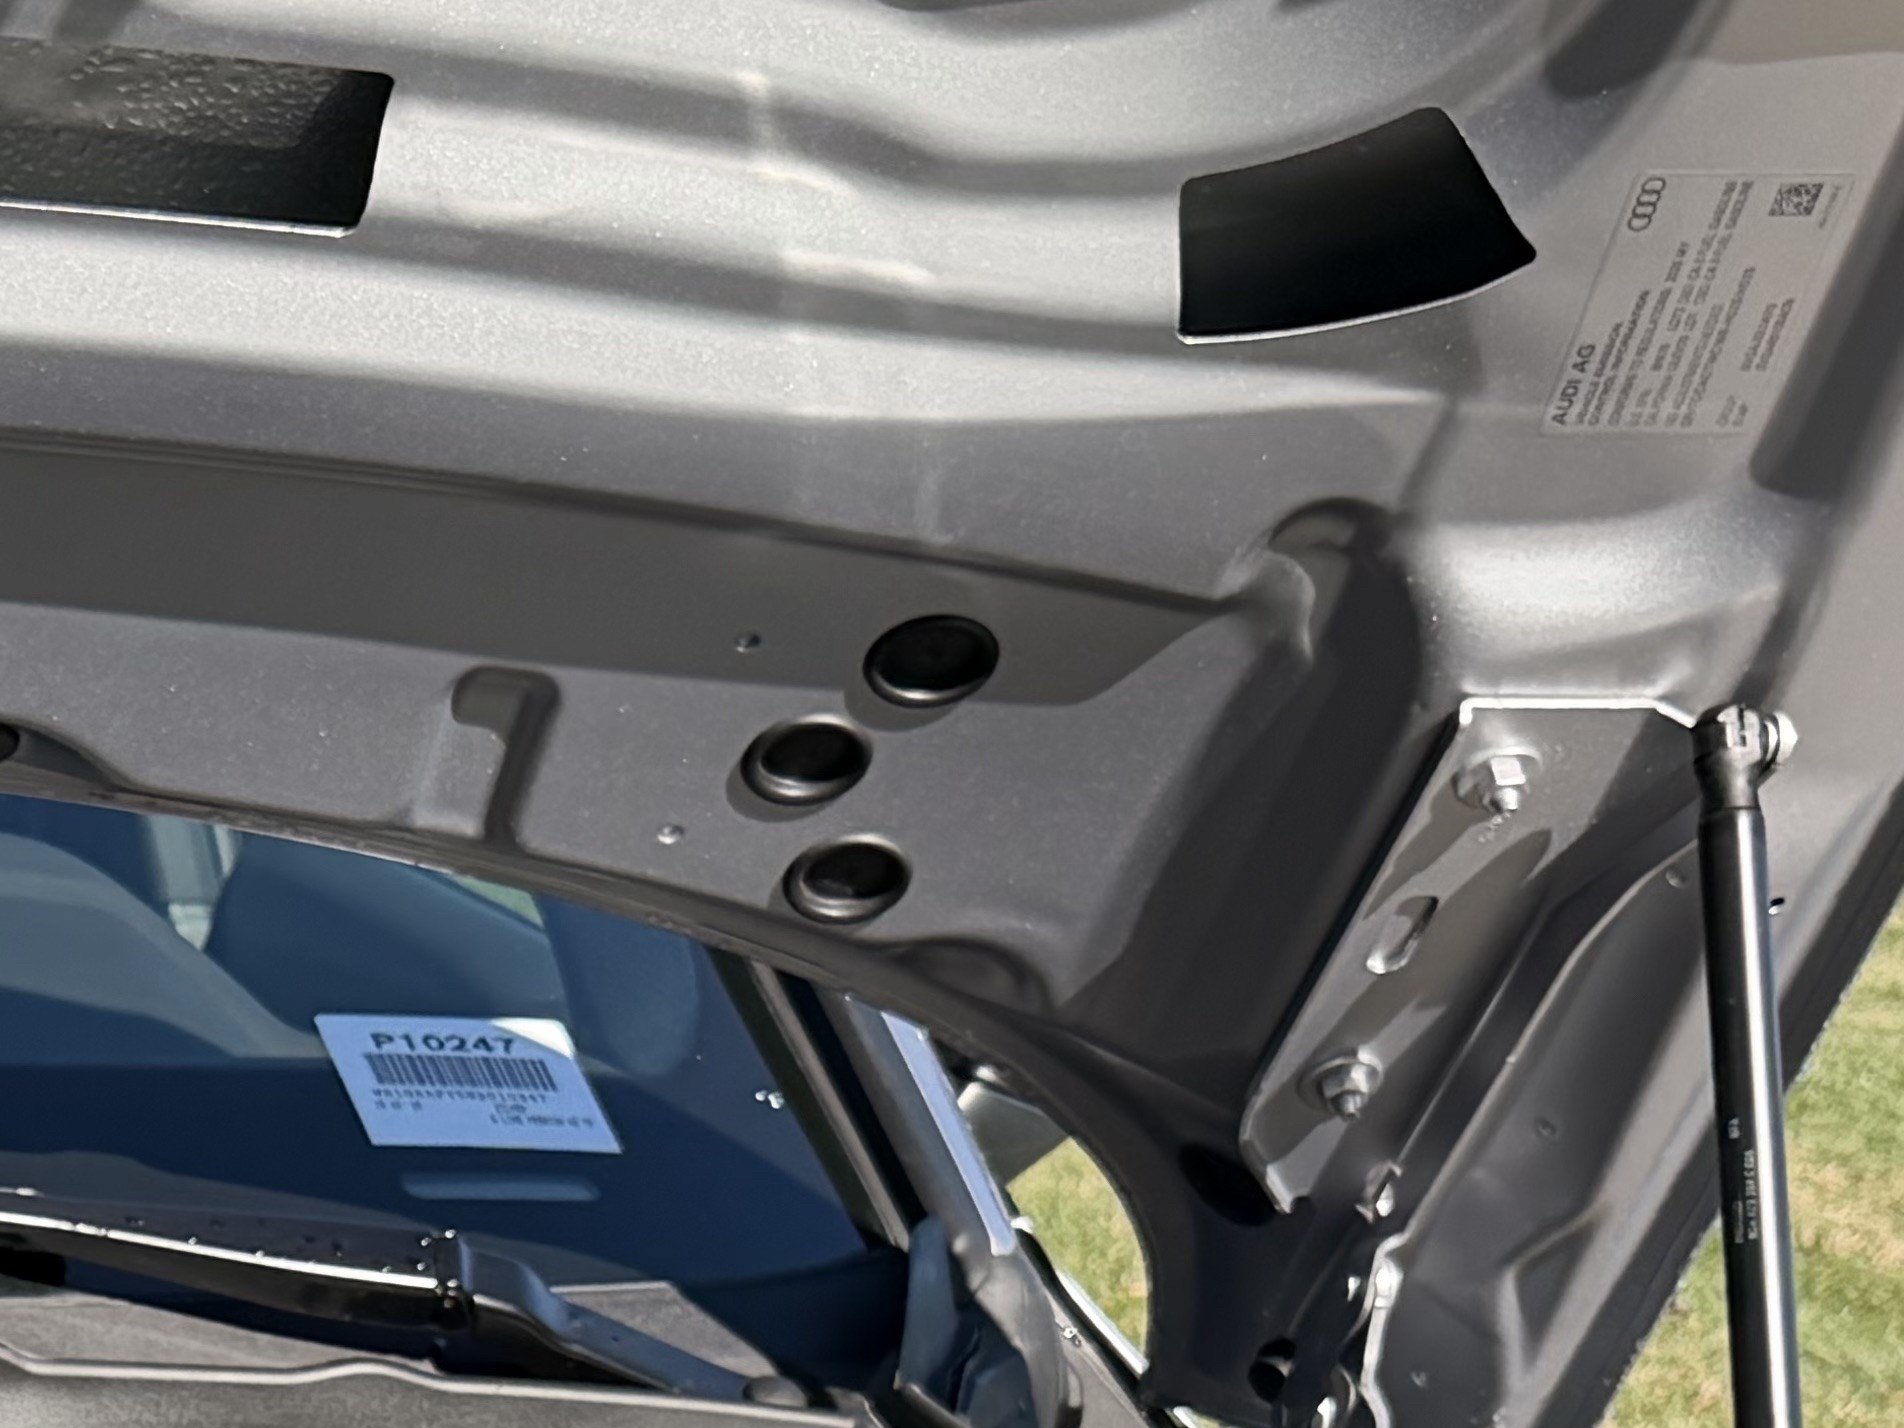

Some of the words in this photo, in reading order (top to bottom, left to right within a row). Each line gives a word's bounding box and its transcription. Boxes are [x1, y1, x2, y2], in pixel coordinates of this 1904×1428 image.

[1550, 379, 1583, 424] AUDI
[1569, 344, 1596, 373] AG
[370, 1032, 515, 1055] P10247
